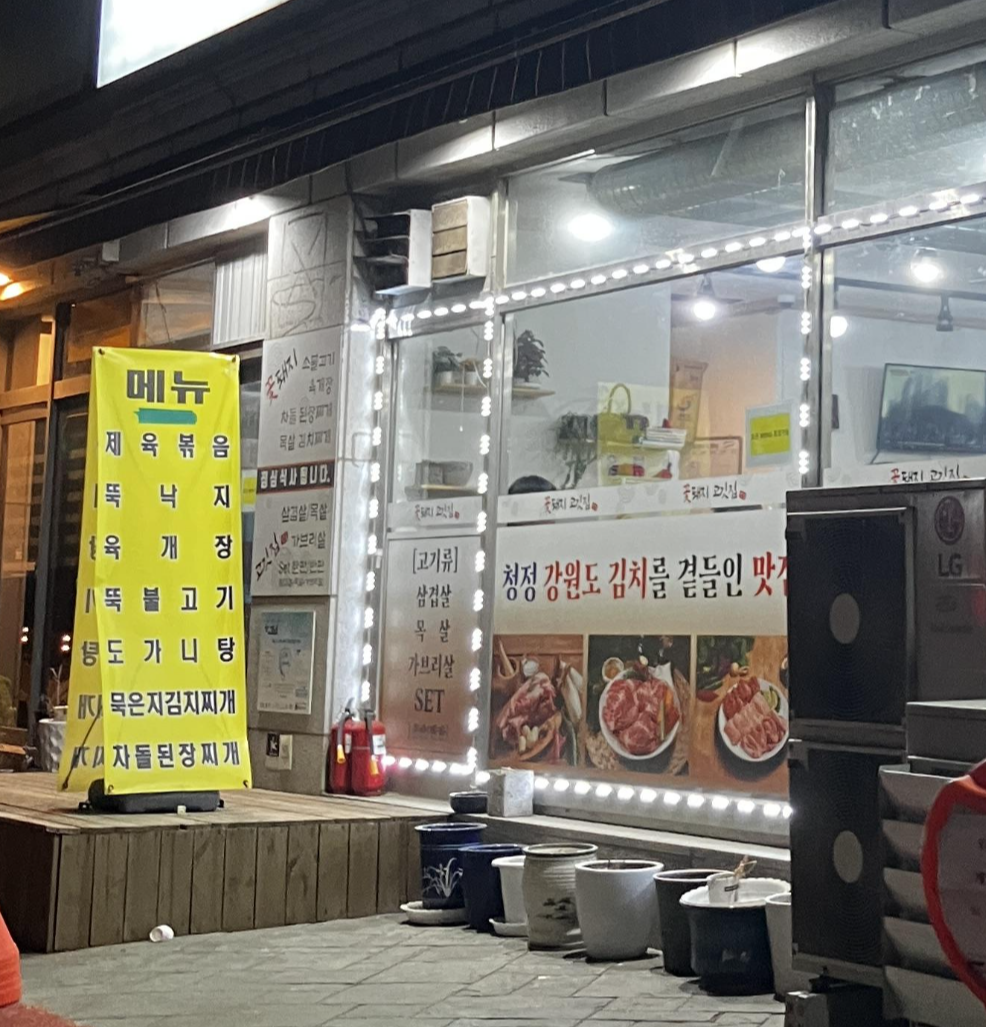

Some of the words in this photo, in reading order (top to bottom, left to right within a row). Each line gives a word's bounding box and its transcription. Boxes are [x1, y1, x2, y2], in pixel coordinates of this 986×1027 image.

[126, 369, 211, 405] 메뉴
[503, 561, 537, 602] 청정
[543, 559, 601, 602] 강원도
[608, 556, 670, 600] 김치를
[678, 552, 743, 599] 곁들인
[937, 553, 963, 578] LG
[416, 584, 452, 608] 삼겹살
[408, 653, 455, 679] 가브리살
[110, 689, 236, 717] 묵은지김치찌개
[414, 688, 446, 714] SET
[112, 740, 241, 770] 차돌된장찌개
